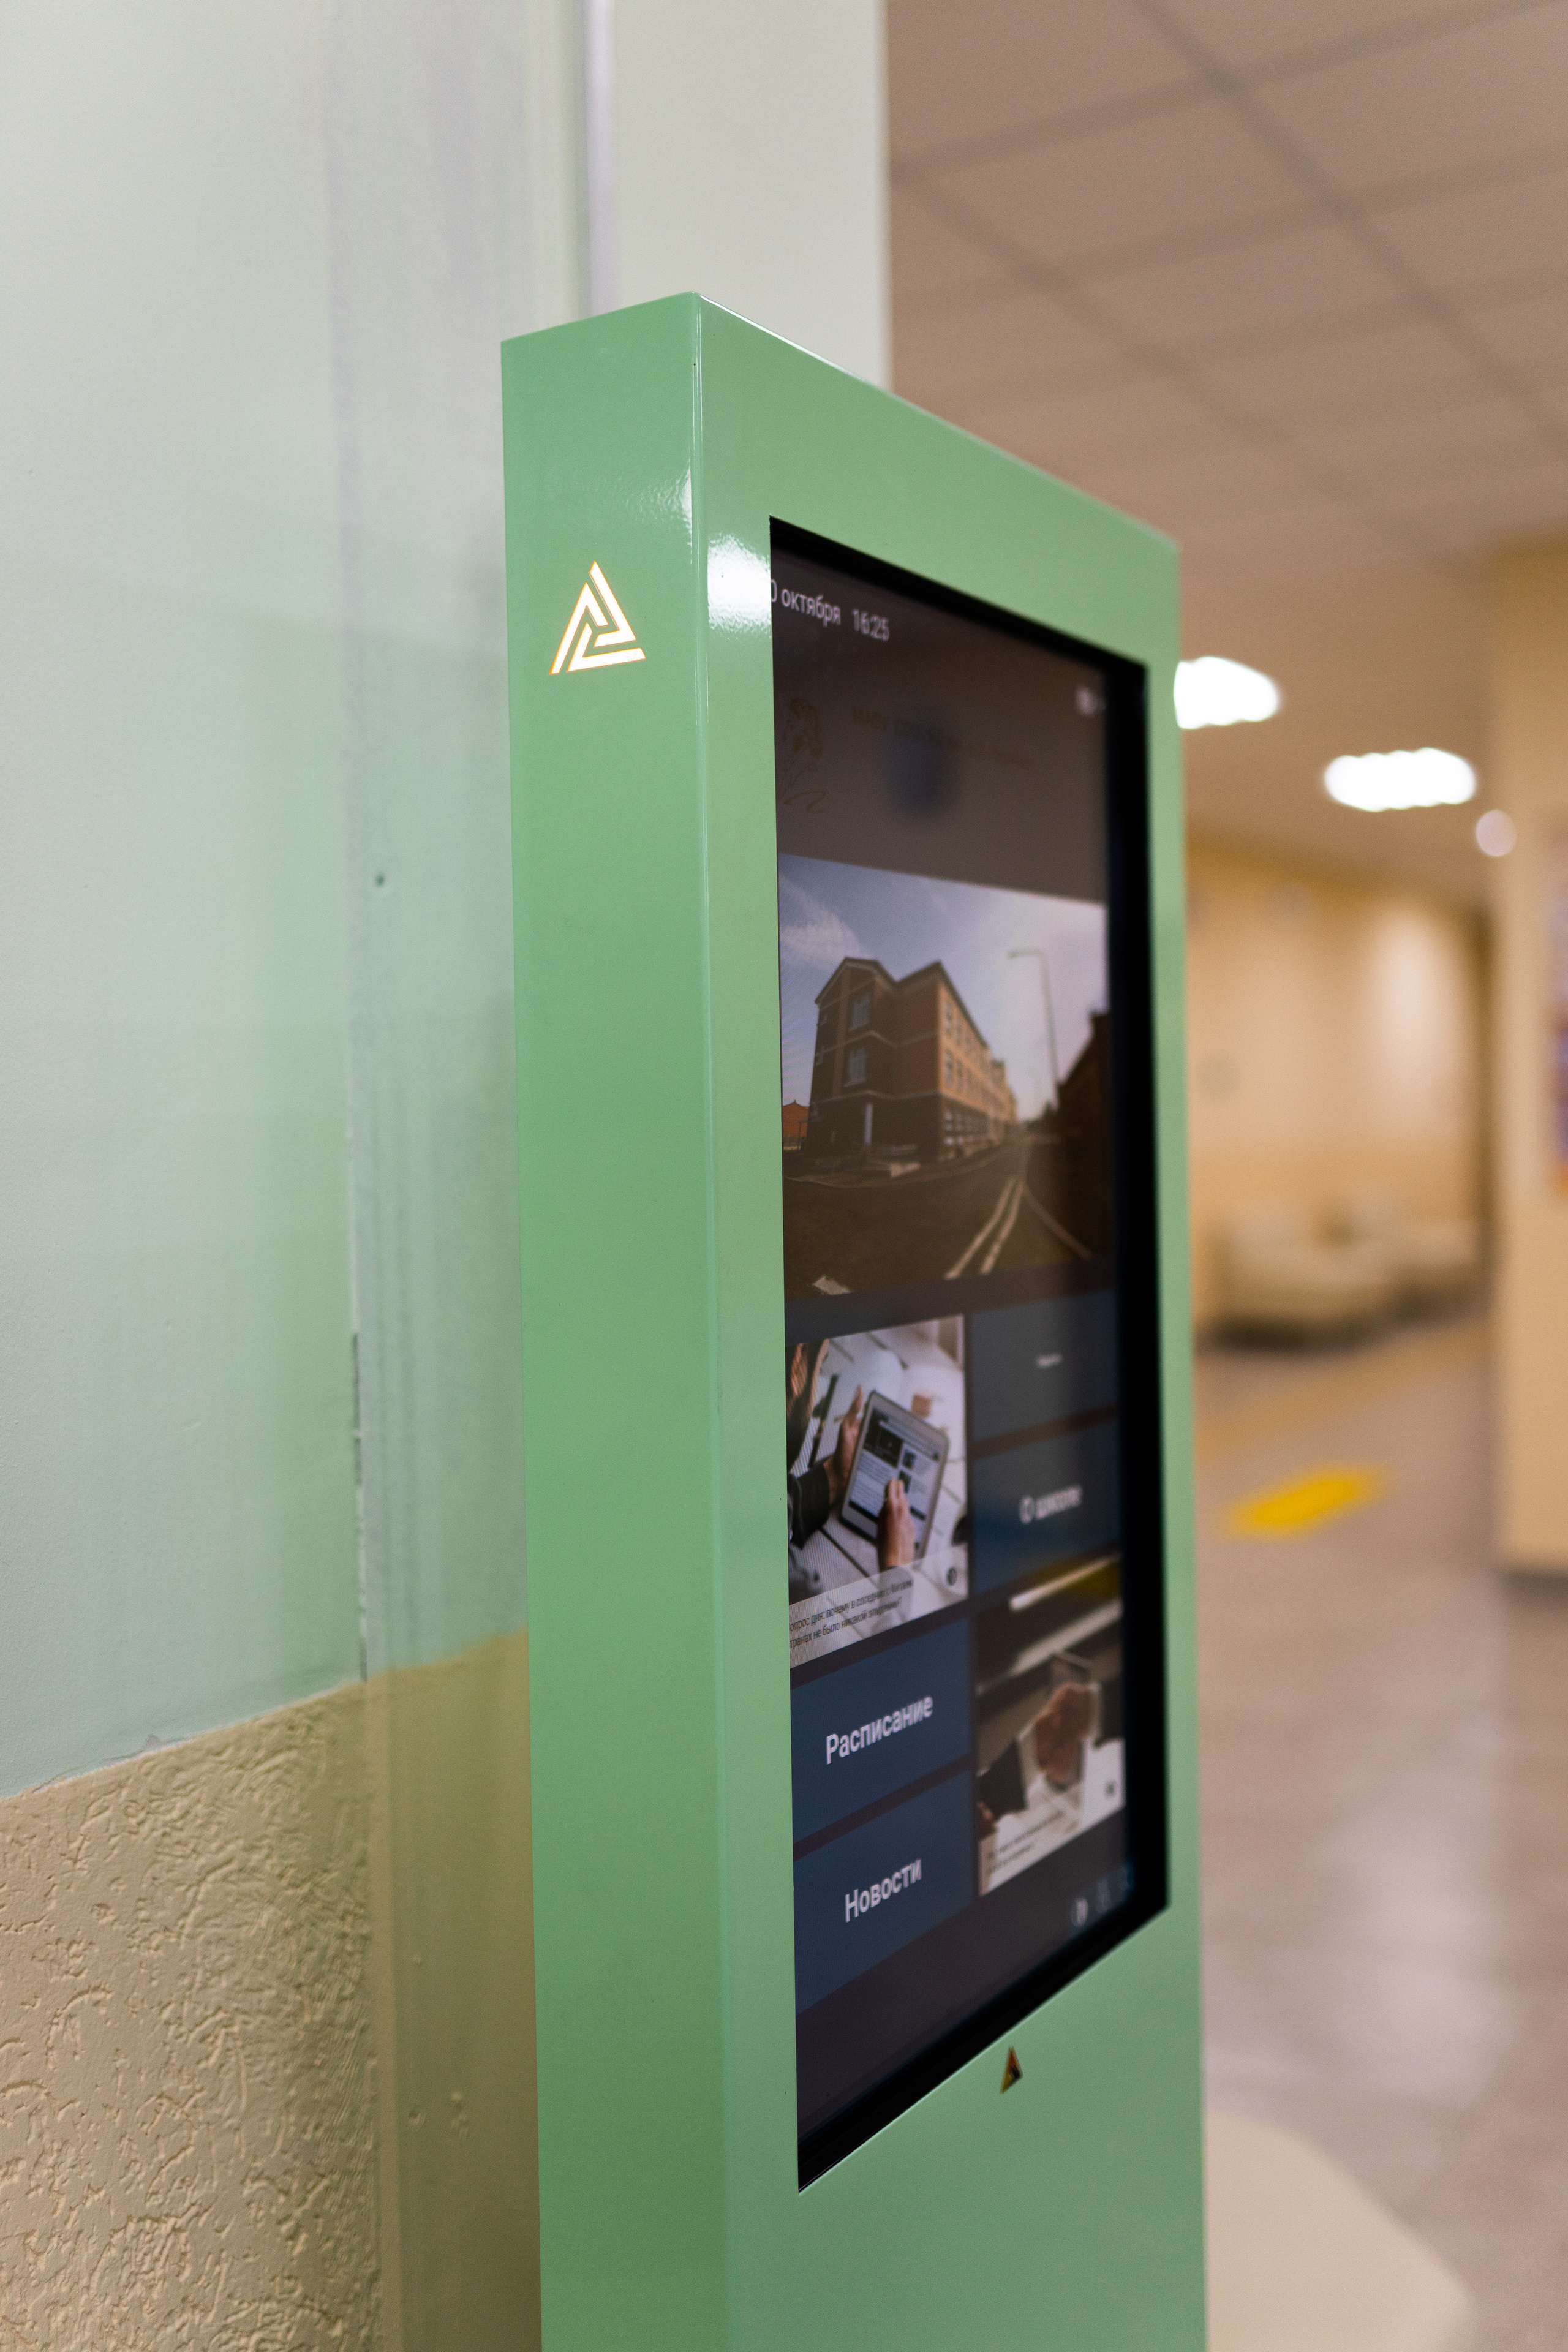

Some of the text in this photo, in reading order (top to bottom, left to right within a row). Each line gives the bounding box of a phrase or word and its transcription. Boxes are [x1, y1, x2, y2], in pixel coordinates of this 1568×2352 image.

[781, 589, 841, 628] октября
[789, 1617, 810, 1632] опрос
[813, 1629, 822, 1639] не
[823, 1622, 840, 1636] было
[826, 1695, 933, 1765] Расписание
[845, 1859, 922, 1923] Новости
